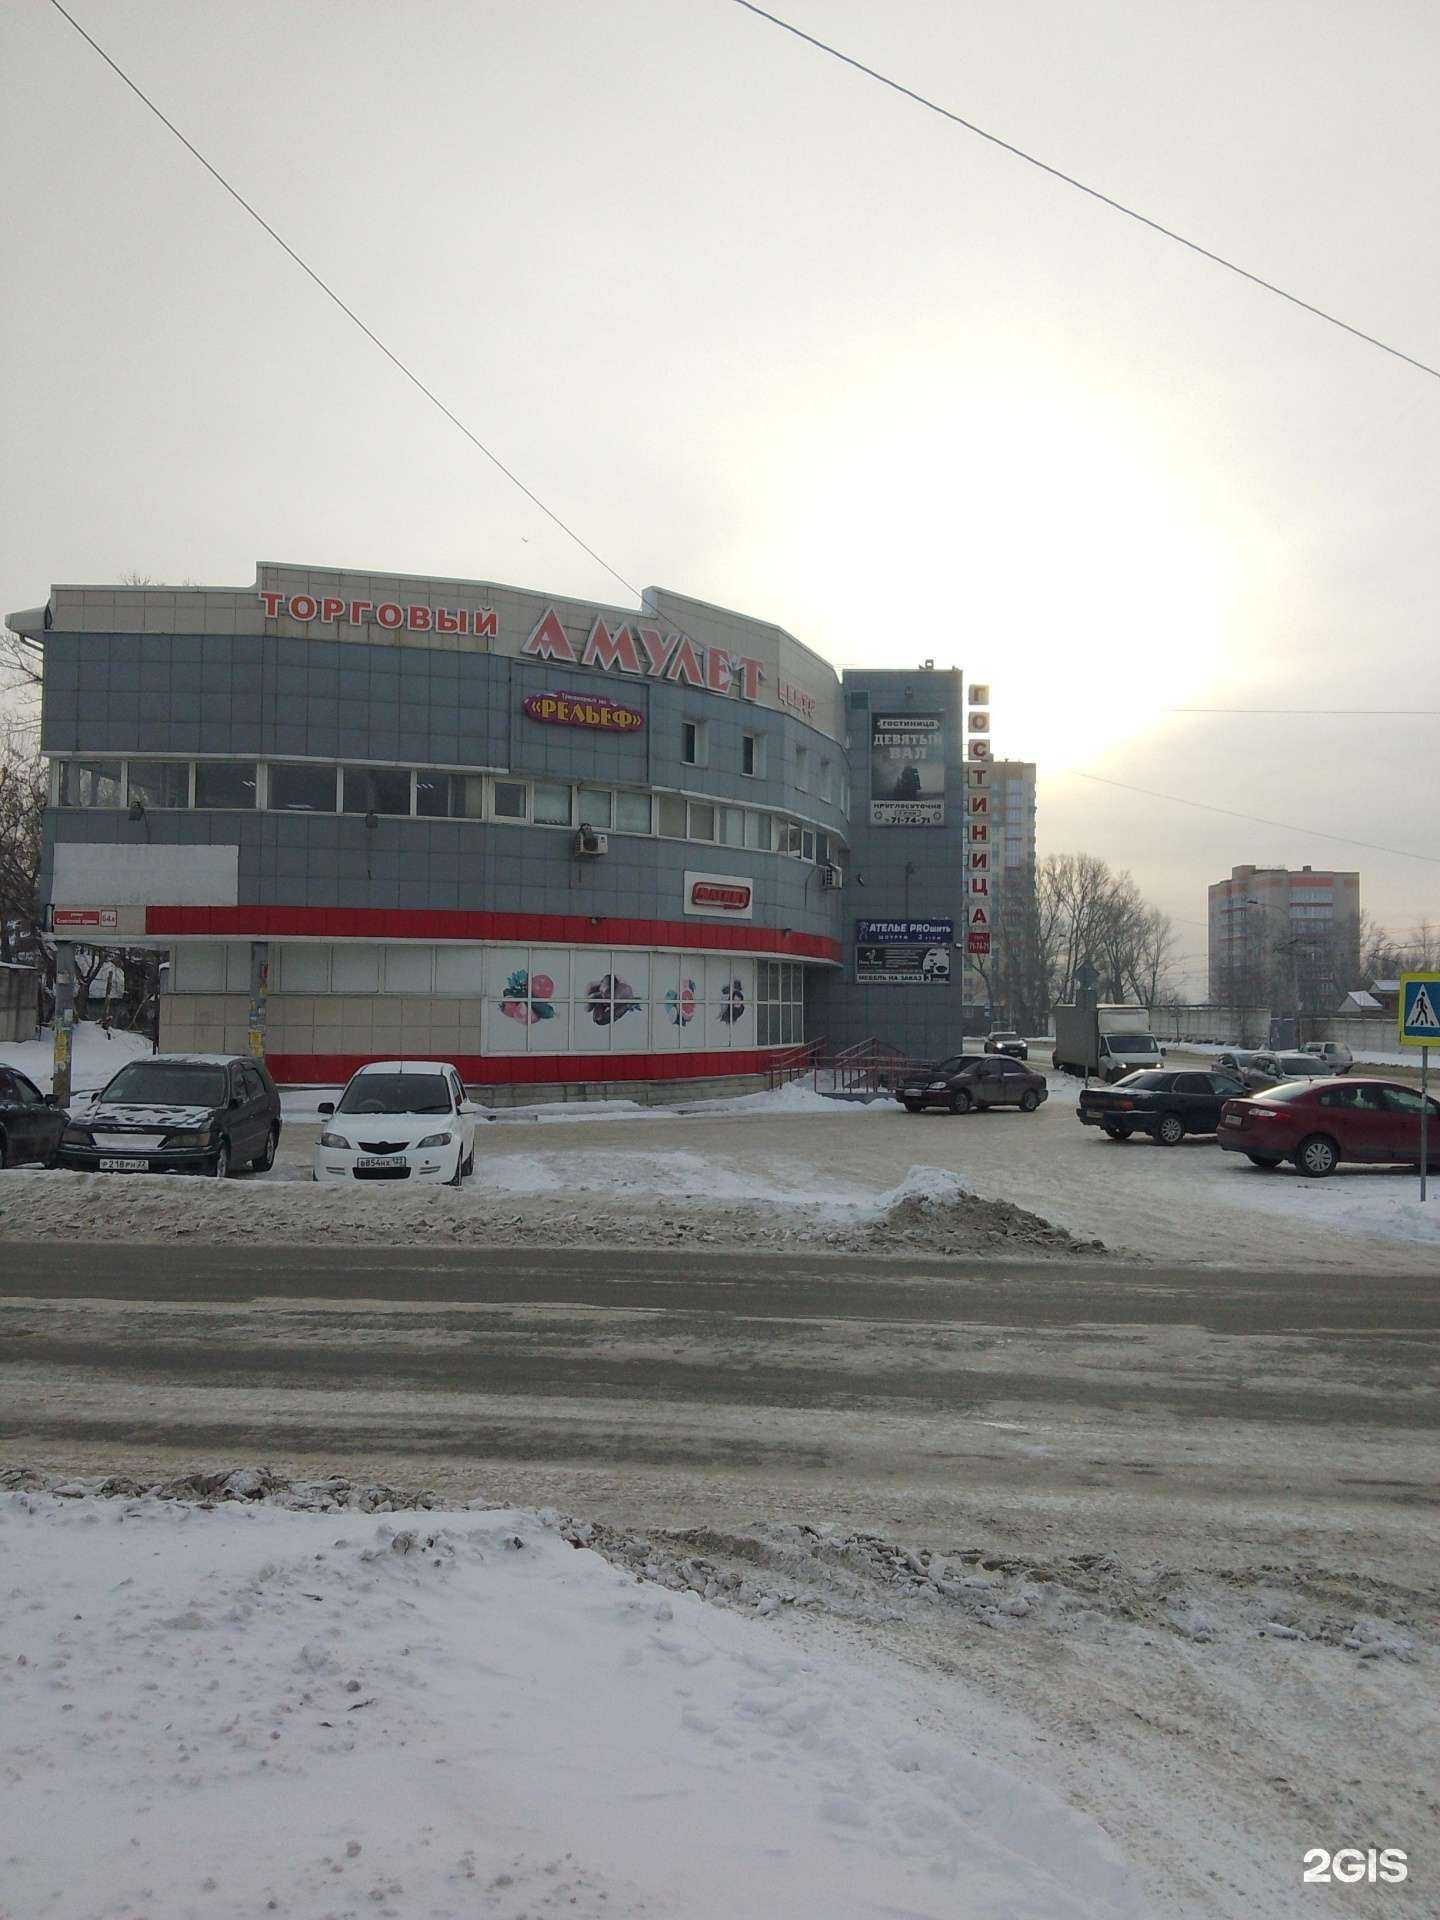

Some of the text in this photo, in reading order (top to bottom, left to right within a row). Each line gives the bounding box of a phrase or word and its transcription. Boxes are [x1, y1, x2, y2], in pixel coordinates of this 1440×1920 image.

[259, 591, 499, 637] ТОРГОВЫЙ
[520, 605, 767, 702] АМУЛЕТ
[889, 747, 927, 760] ВАЛ
[970, 686, 989, 925] ГОСТИНИЦА
[869, 923, 908, 933] АТЕЛЬЕ
